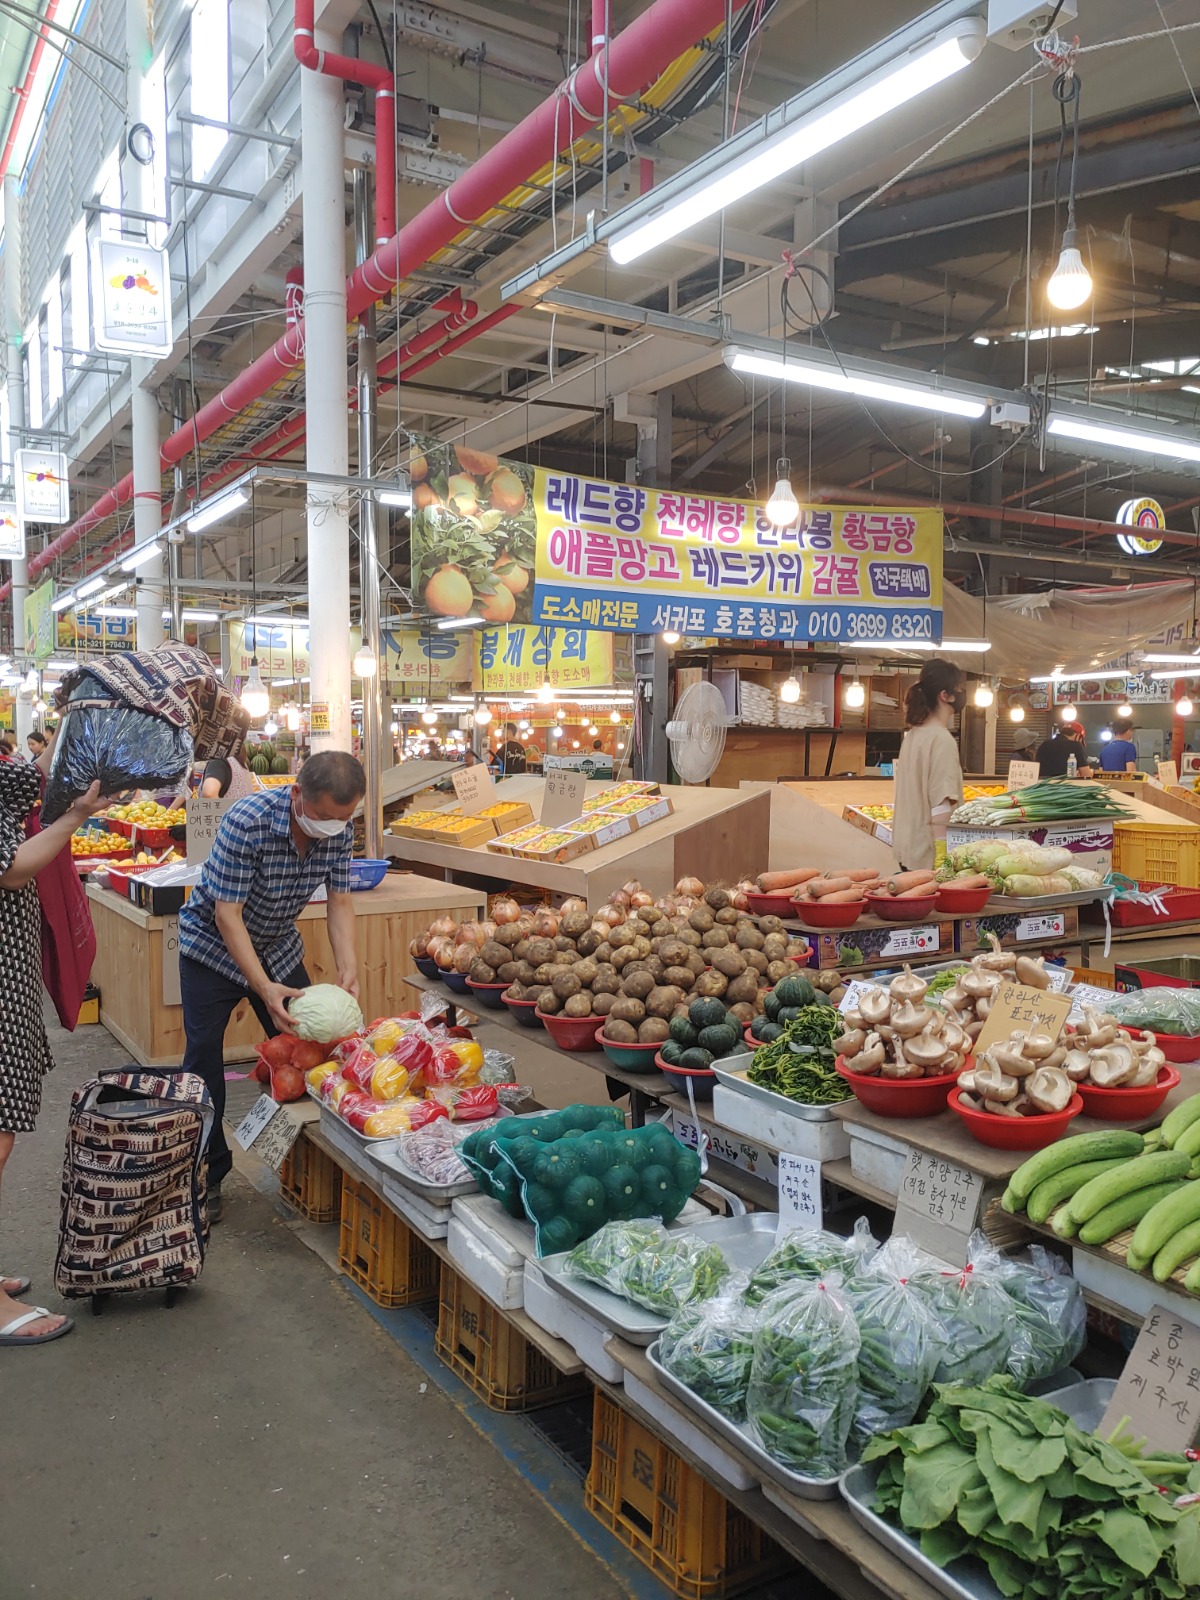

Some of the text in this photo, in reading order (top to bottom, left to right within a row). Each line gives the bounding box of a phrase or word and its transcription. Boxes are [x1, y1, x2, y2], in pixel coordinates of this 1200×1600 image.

[547, 477, 646, 532] 레드향
[657, 492, 745, 544] 천혜향
[841, 513, 916, 554] 황금향
[550, 529, 928, 595] 애플망고 레드키위 감귤 전국택배
[541, 596, 932, 639] 도소매전문 서귀포 호준청과 010 3699 8320
[479, 626, 588, 669] 봉개상회
[563, 666, 590, 682] 도소매
[548, 782, 576, 798] 황금향
[1003, 986, 1043, 1006] 한라산
[911, 1151, 975, 1192] 햇 청양고추
[931, 1184, 947, 1203] 농사
[1130, 1373, 1190, 1425] 제주산
